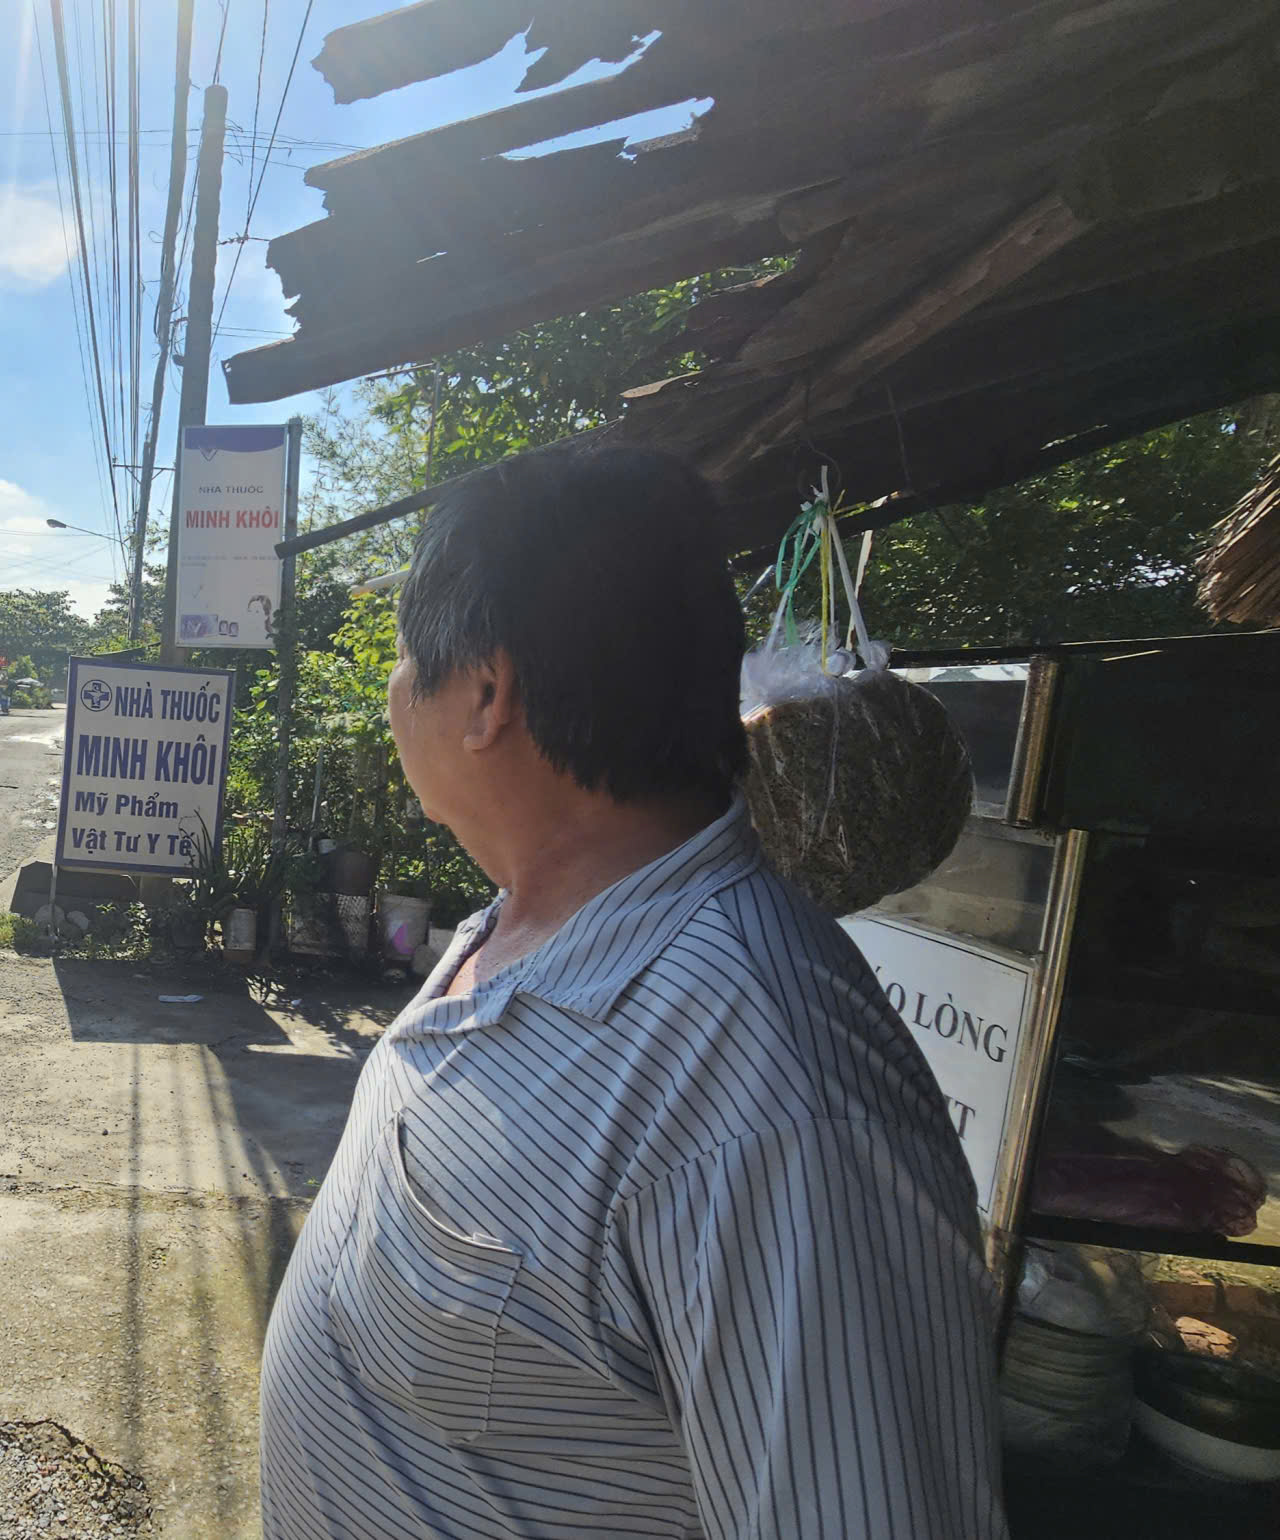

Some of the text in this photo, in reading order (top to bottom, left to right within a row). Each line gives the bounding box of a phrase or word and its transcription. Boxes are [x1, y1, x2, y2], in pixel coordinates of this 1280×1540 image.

[185, 505, 279, 529] MINH KHÔI
[114, 681, 221, 723] NHÀ THUỐC
[76, 734, 217, 786] MINH KHÔI
[74, 791, 179, 819] Mỹ Phẩm
[72, 827, 195, 857] Vật Tư Y Tế
[913, 992, 1009, 1063] LÒNG
